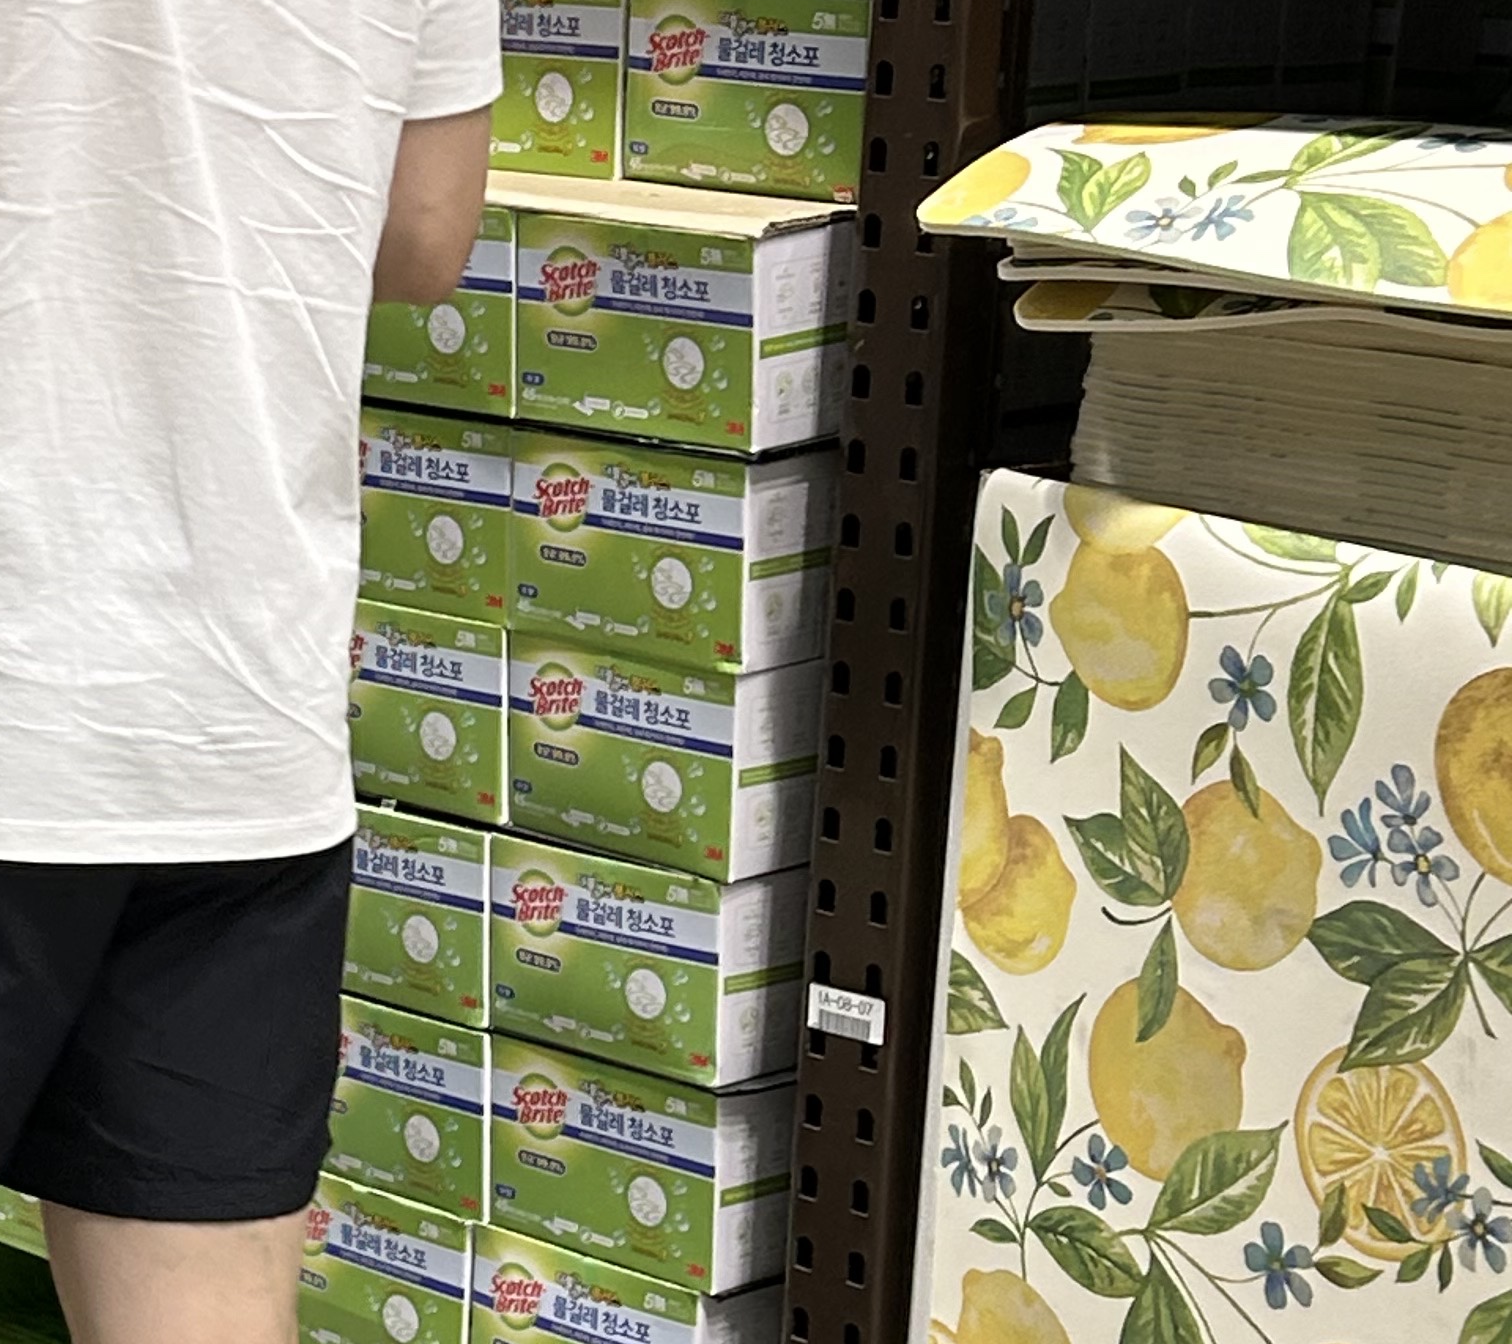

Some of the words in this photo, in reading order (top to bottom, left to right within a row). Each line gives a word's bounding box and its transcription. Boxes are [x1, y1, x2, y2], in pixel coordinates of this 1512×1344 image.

[501, 11, 532, 36] 걸레
[652, 52, 700, 69] Brite
[545, 283, 593, 301] Brite
[540, 498, 585, 518] Brite
[534, 696, 578, 718] Brite
[515, 903, 560, 925] Brite
[518, 1105, 562, 1129] Brite
[492, 1294, 538, 1320] Brite
